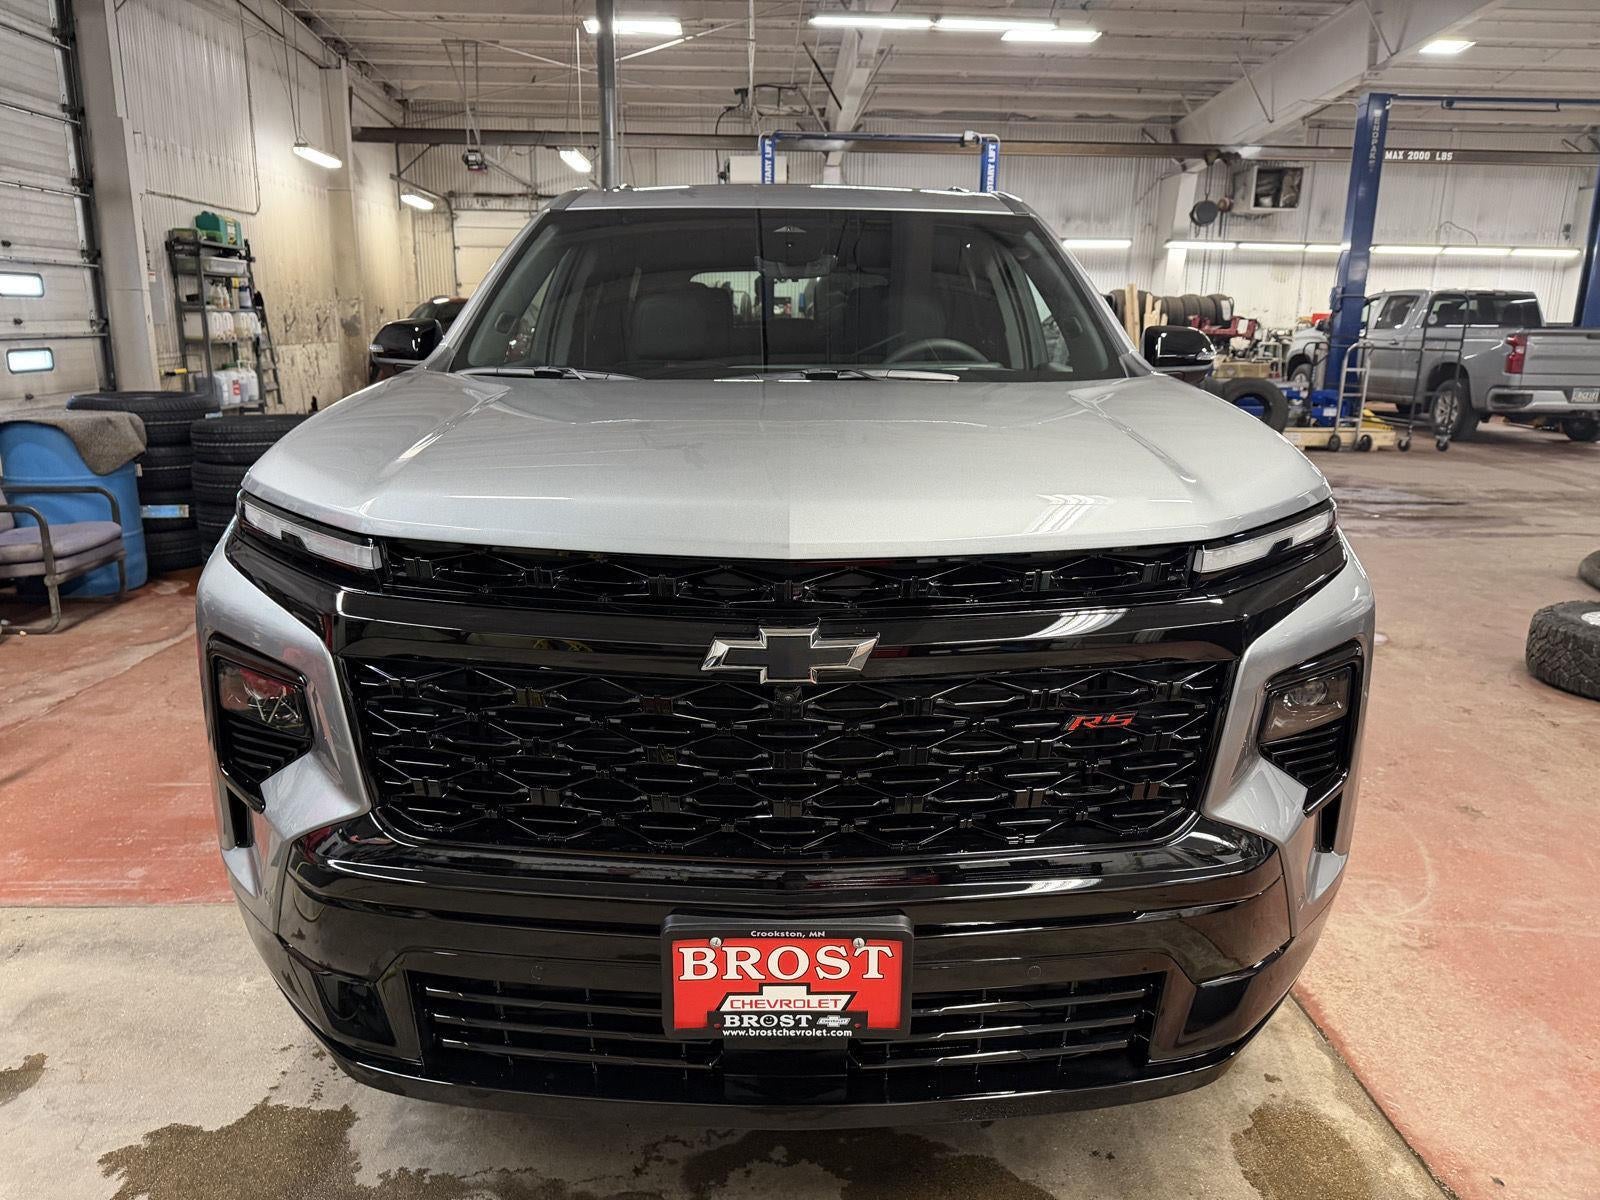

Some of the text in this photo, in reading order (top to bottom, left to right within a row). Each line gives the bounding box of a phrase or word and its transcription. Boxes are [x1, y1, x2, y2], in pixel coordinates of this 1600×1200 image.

[1385, 150, 1453, 161] MAX 2000 LBS
[987, 144, 996, 192] OTARY LIFT
[1064, 712, 1137, 731] RS
[750, 930, 806, 938] Crookston,
[678, 945, 894, 981] BROST
[730, 999, 842, 1009] CHEVROLET
[723, 1014, 812, 1028] BROST
[722, 1028, 853, 1038] www.brostchevrolet.com
